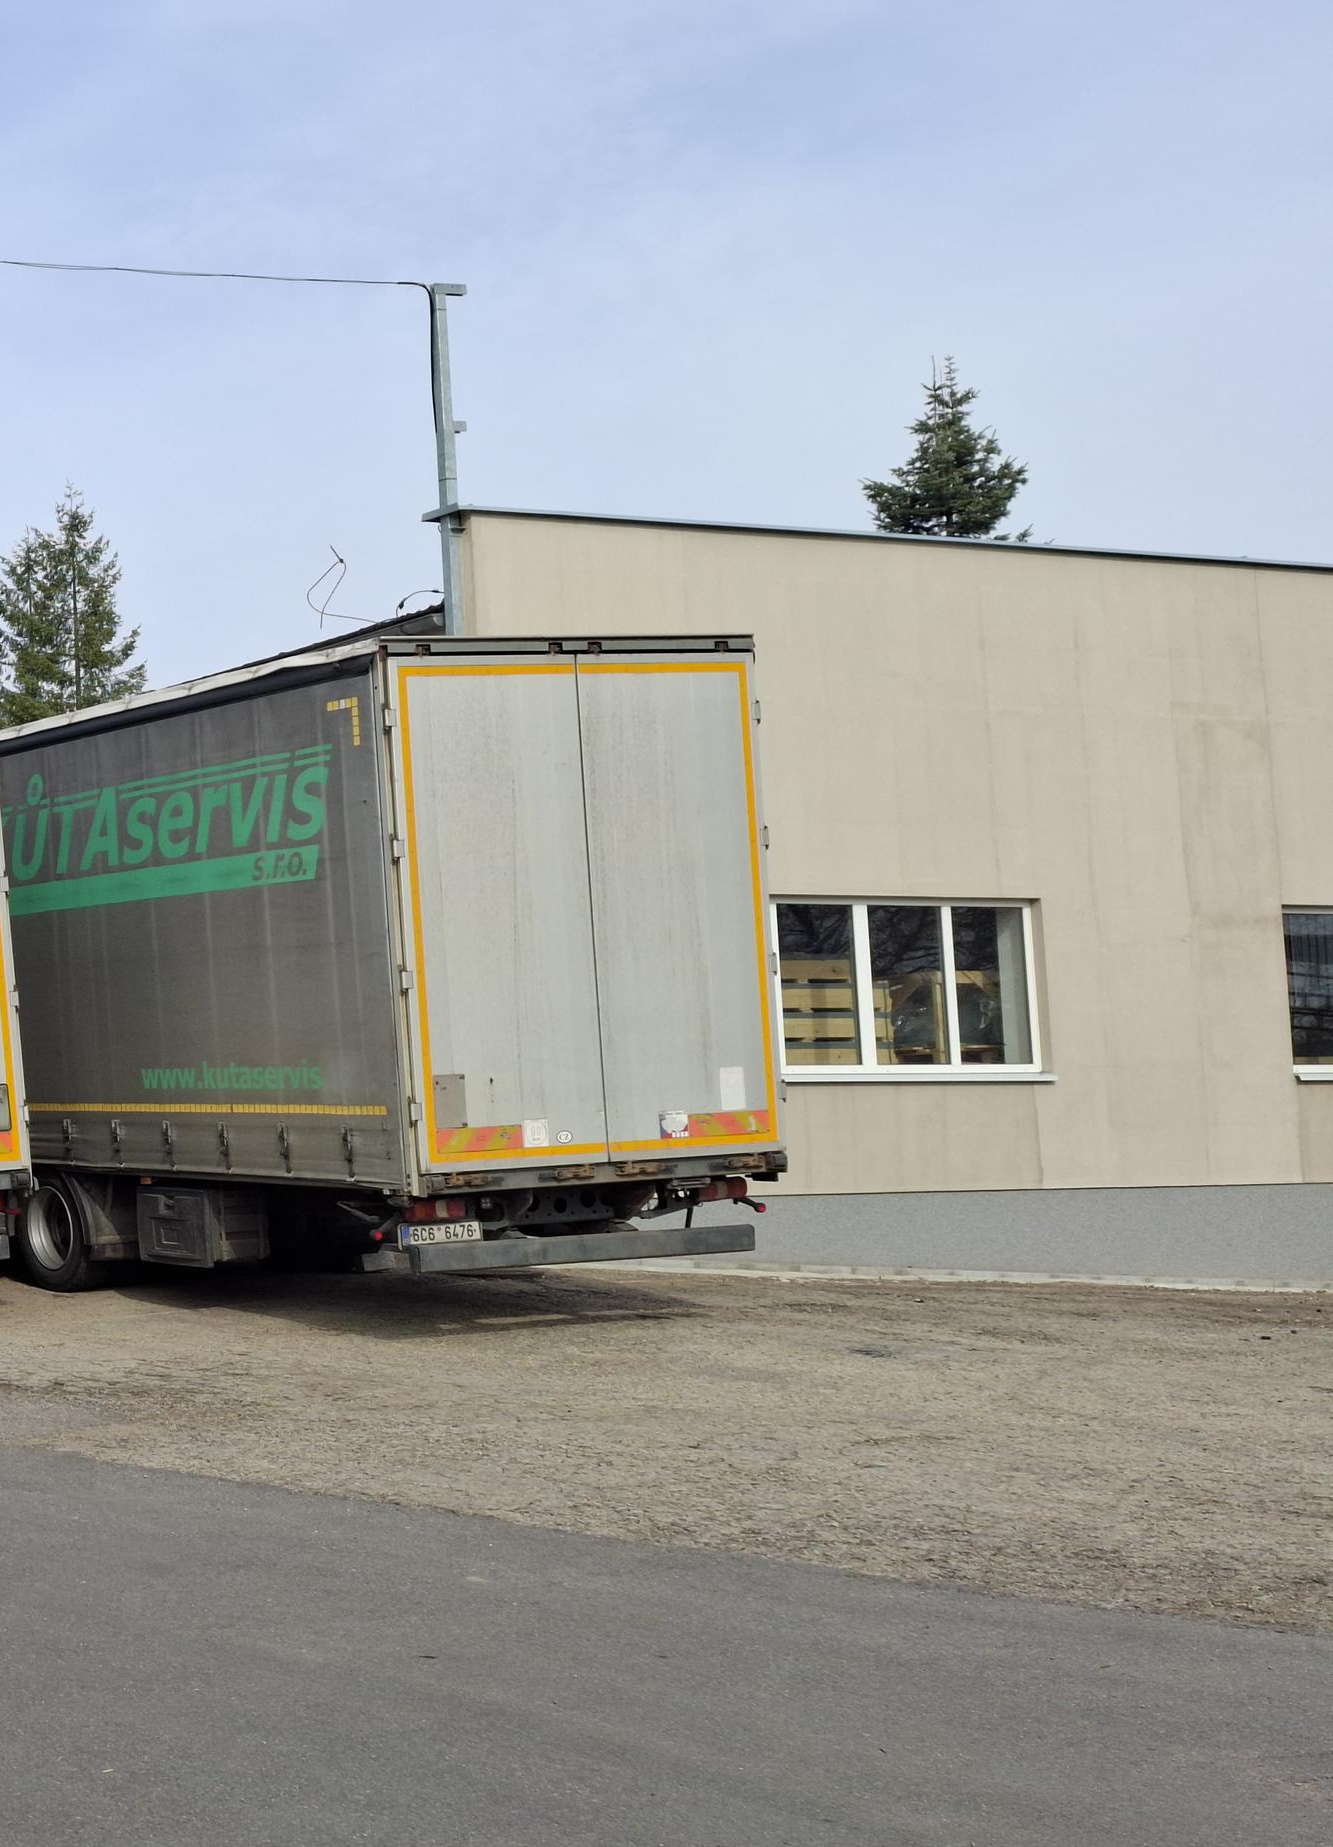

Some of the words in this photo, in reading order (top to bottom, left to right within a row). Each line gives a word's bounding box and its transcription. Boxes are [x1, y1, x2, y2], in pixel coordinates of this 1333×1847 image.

[3, 766, 330, 880] ŮTAservis
[252, 851, 308, 881] s.r.o.
[413, 1227, 436, 1242] 6C6
[444, 1223, 474, 1240] 6476
